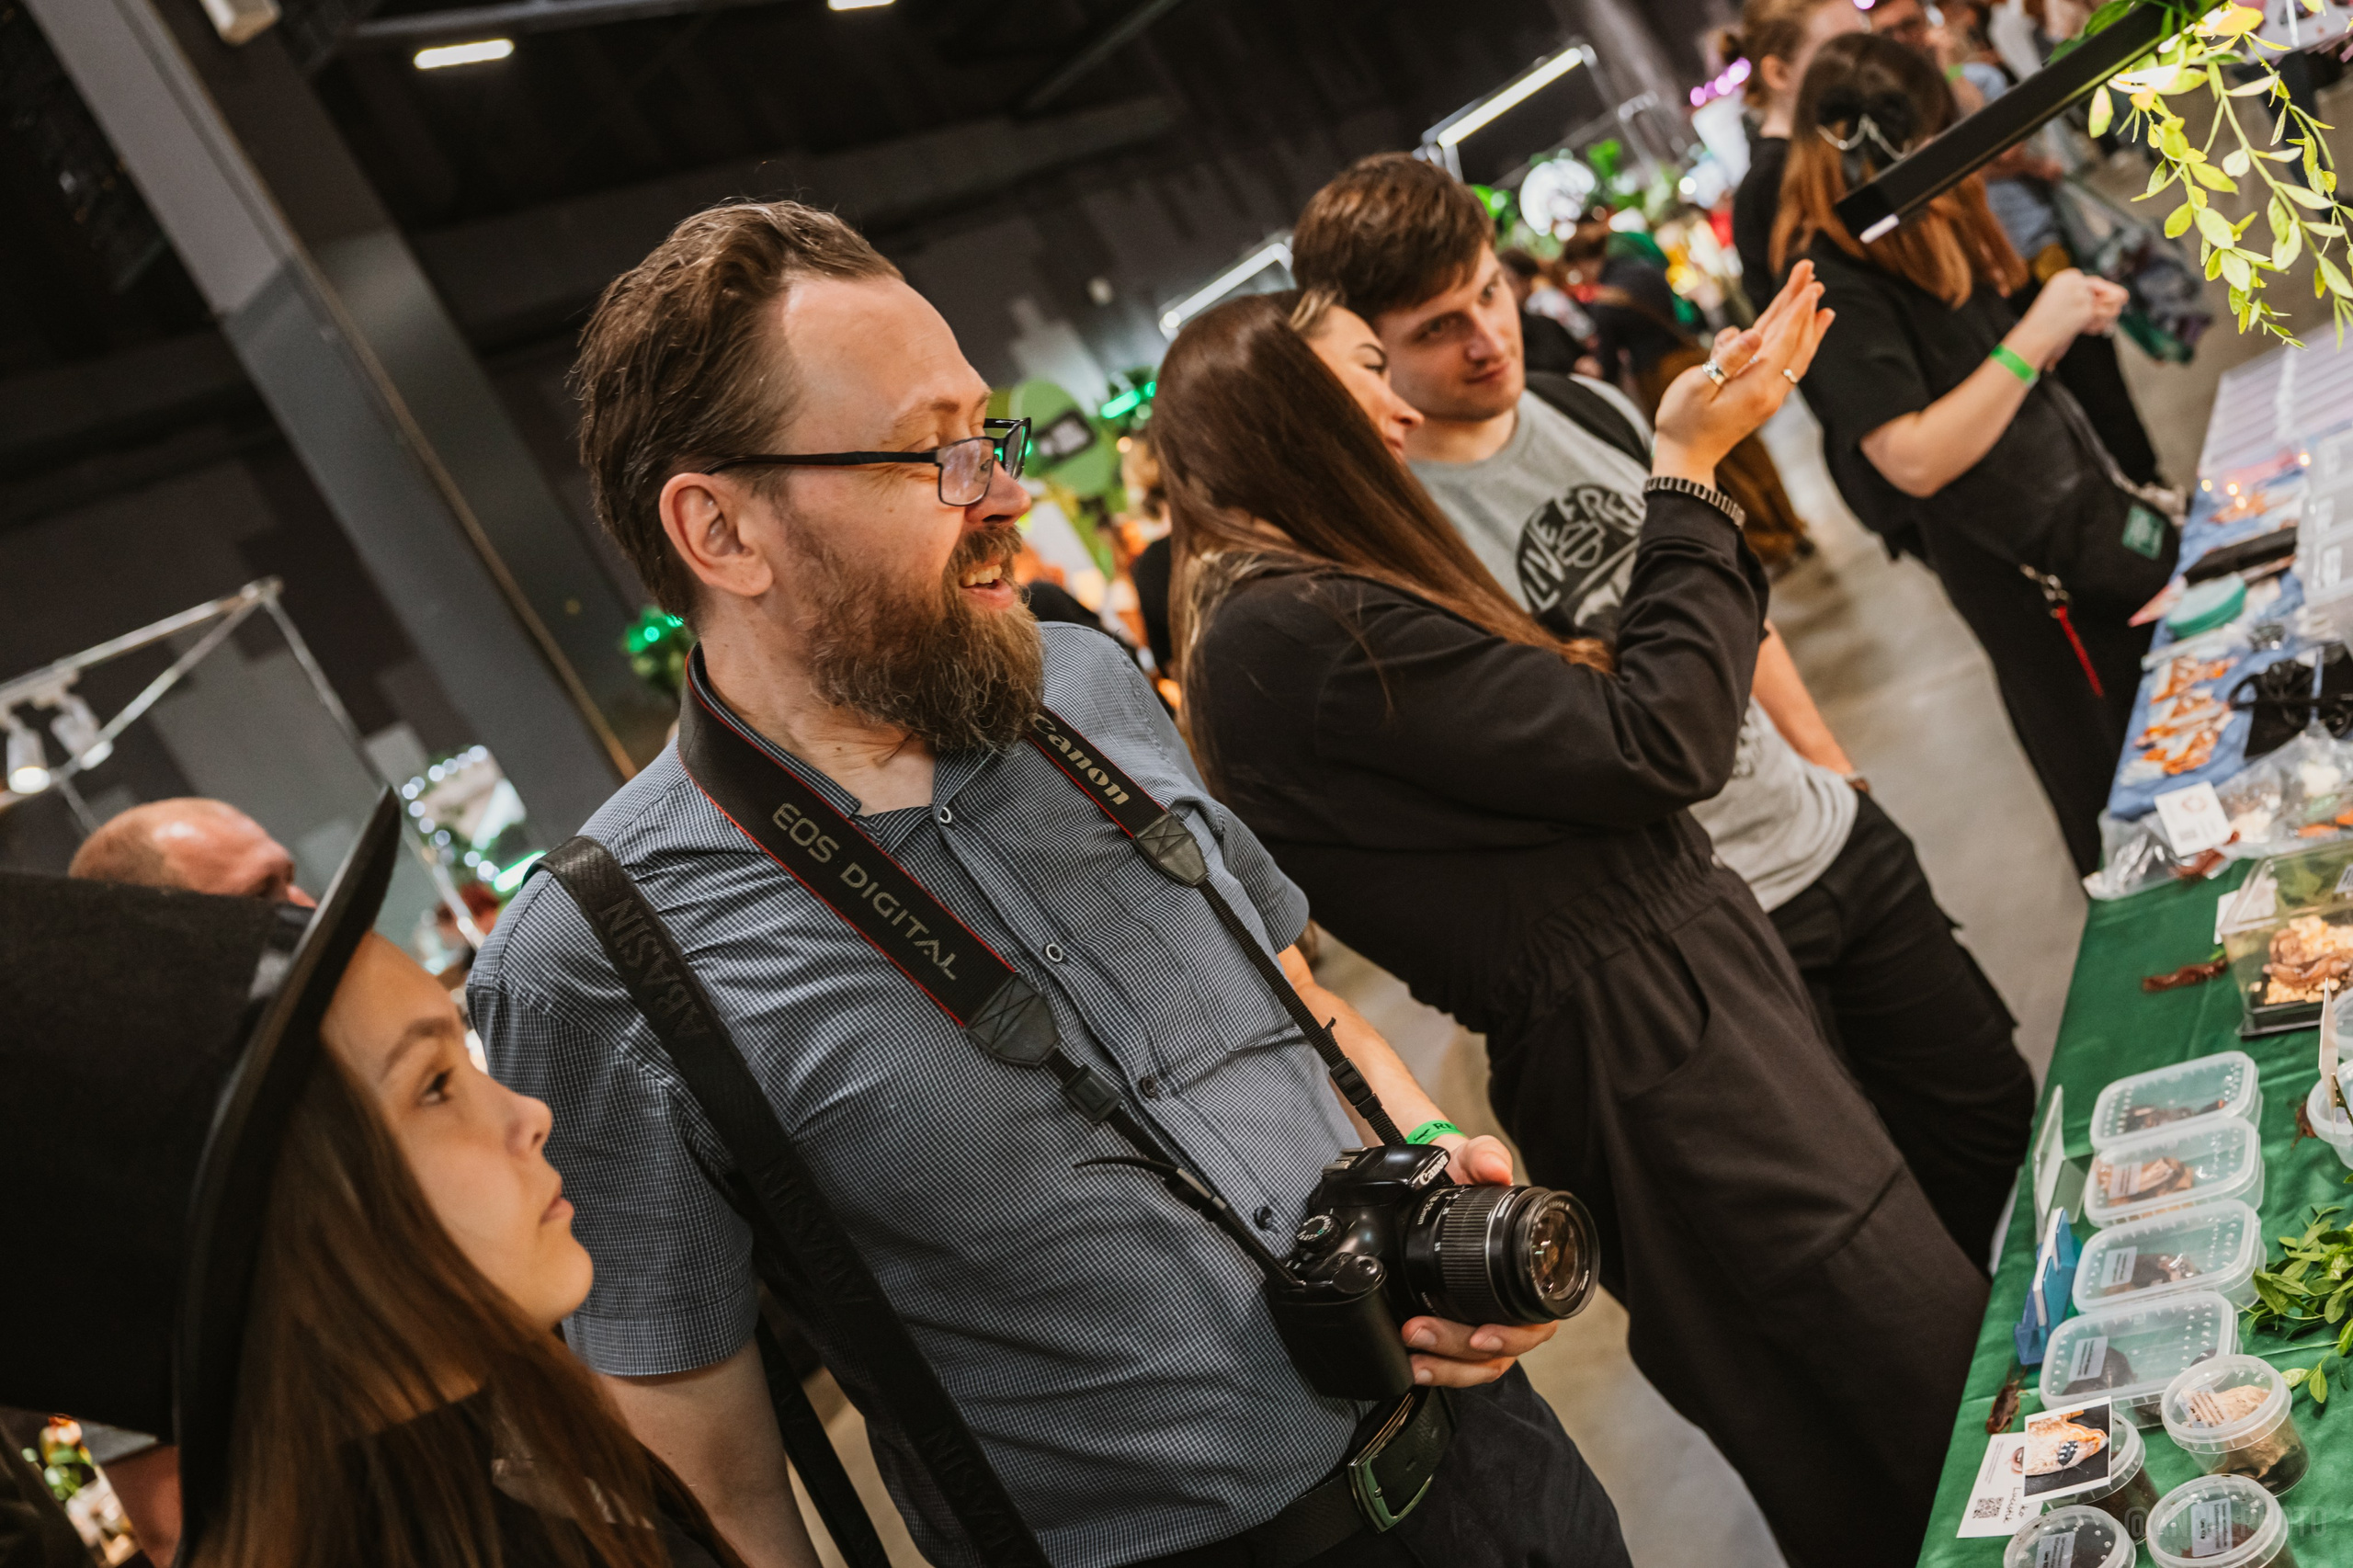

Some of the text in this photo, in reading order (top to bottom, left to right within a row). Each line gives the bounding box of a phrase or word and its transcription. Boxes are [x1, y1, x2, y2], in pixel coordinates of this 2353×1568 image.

[1028, 712, 1130, 805] Canon
[772, 802, 957, 981] EOS DIGITAL
[597, 895, 710, 1040] ABASIN
[1419, 1153, 1449, 1186] Canon
